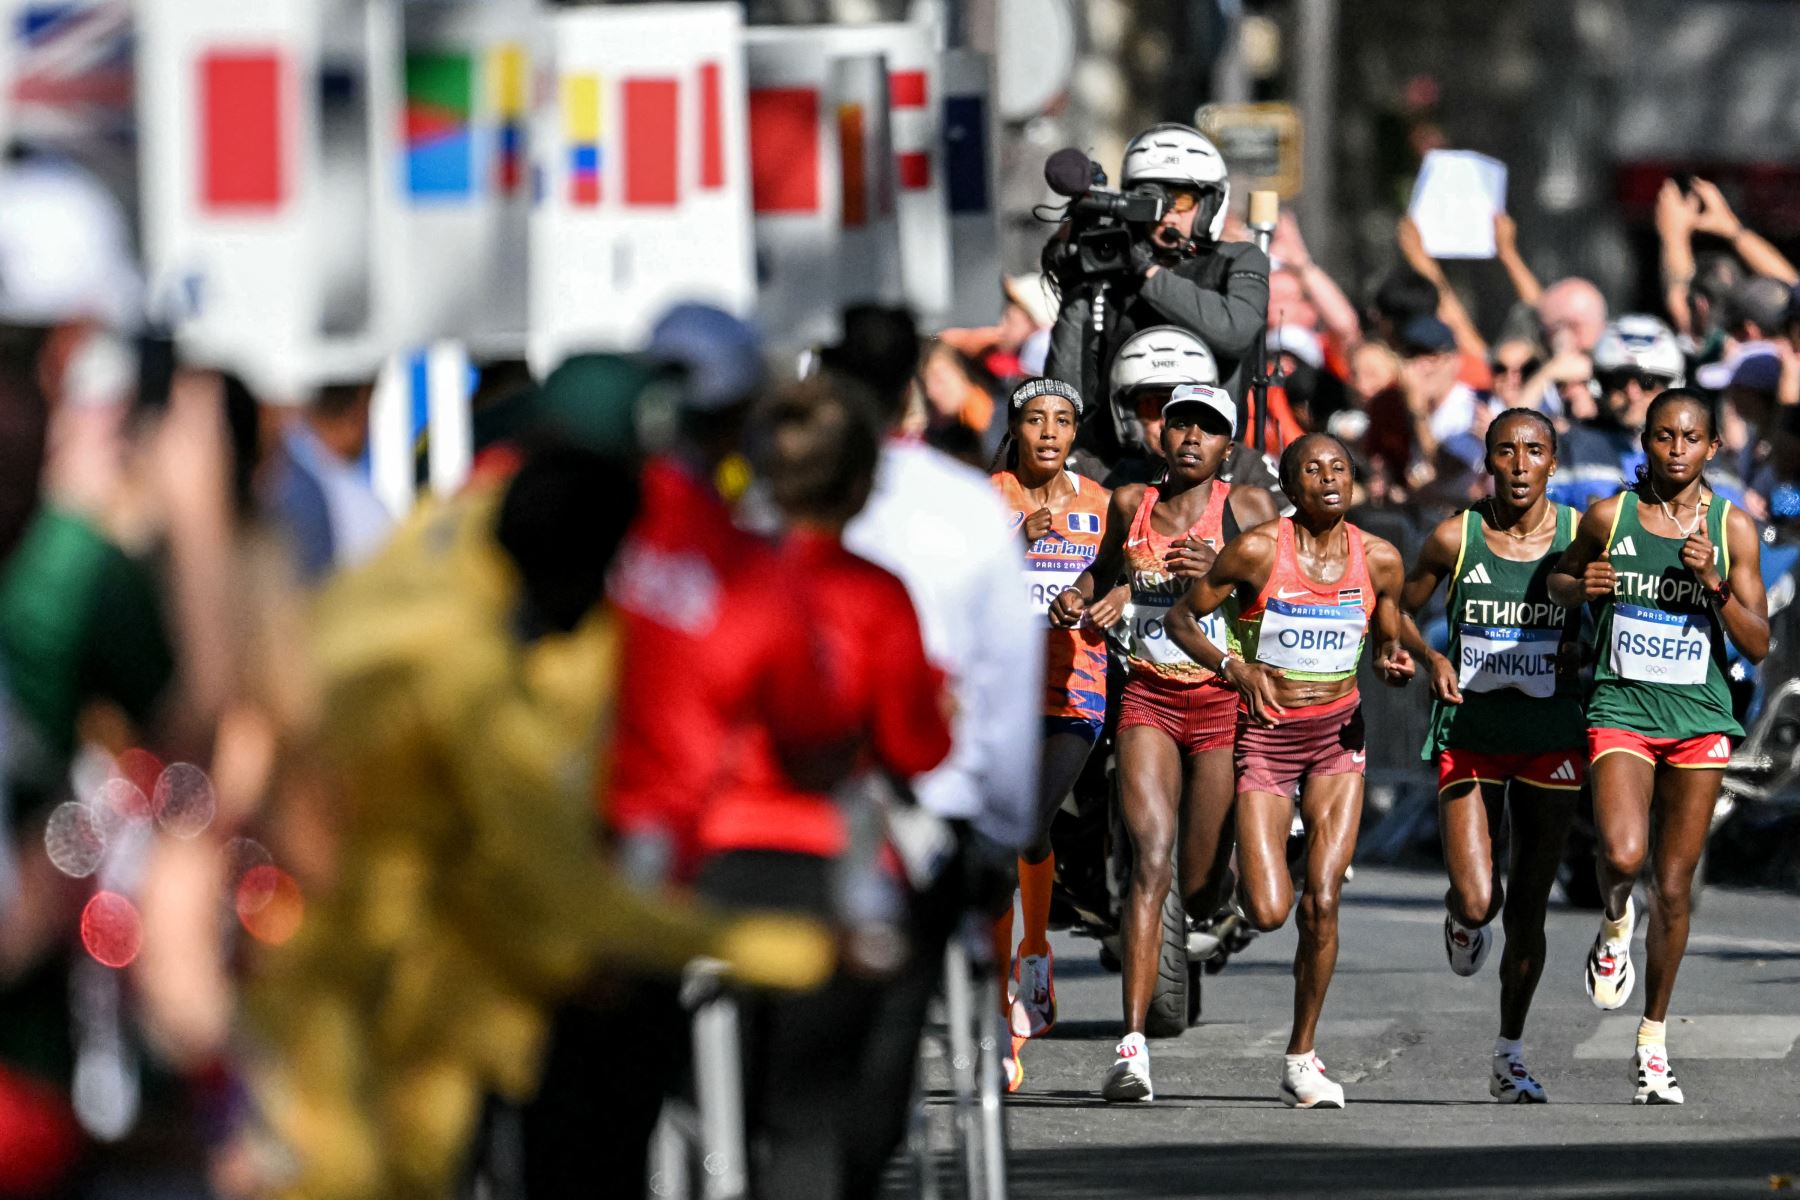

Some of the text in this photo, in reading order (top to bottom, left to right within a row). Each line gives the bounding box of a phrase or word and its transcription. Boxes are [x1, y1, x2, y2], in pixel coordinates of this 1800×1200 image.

[1029, 540, 1096, 558] derland
[1036, 561, 1062, 569] PARIS
[1131, 569, 1196, 593] KENY
[1291, 607, 1316, 616] PARIS
[1318, 608, 1341, 617] 2024
[1465, 599, 1566, 627] ETHIOPIA
[1637, 610, 1663, 621] PARIS
[1278, 628, 1346, 650] OBIRI
[1617, 630, 1703, 661] ASSEFA
